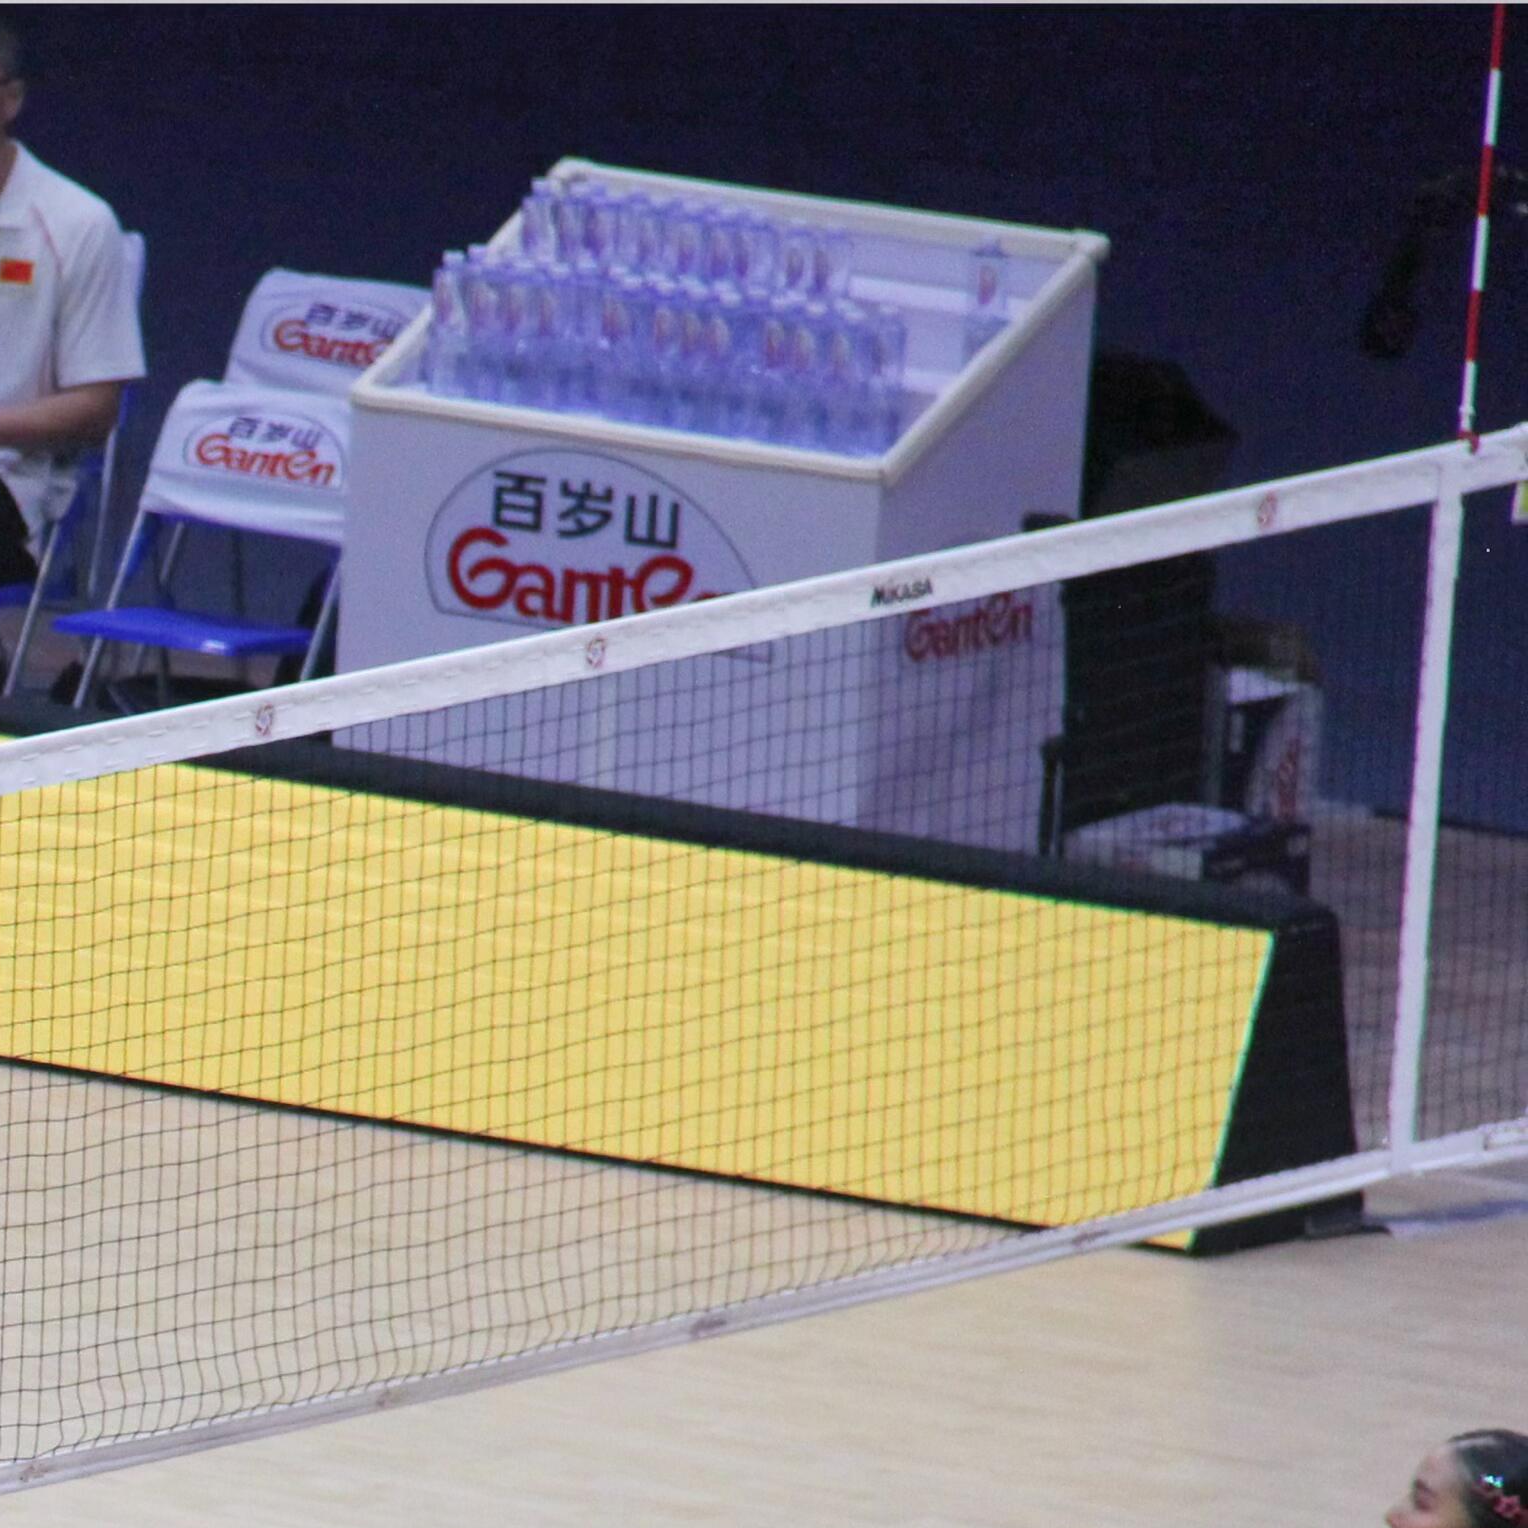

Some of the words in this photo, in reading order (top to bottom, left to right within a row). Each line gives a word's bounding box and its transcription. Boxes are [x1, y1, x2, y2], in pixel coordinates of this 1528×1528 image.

[492, 470, 680, 550] 百岁山
[447, 526, 734, 625] Gante
